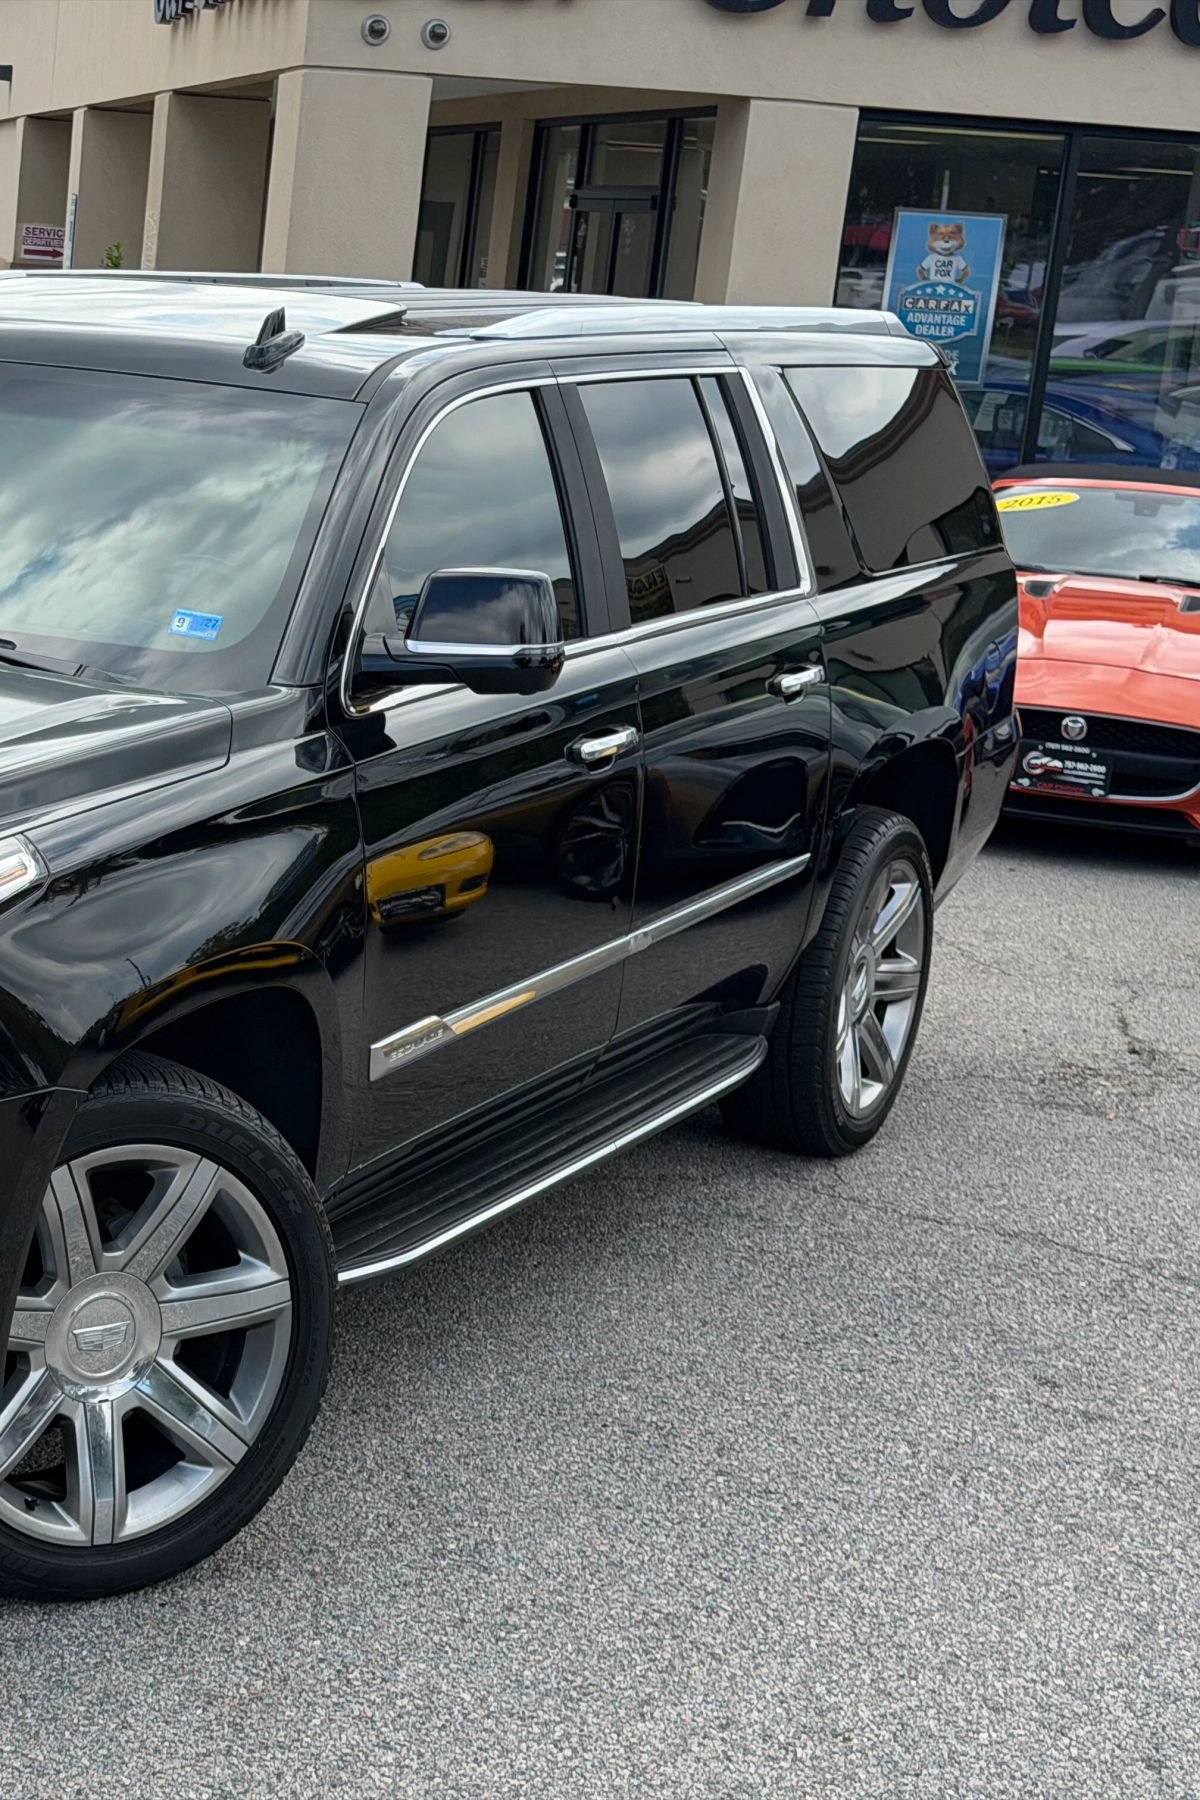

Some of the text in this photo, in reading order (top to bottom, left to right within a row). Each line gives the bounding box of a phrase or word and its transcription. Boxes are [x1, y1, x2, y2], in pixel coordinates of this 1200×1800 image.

[24, 226, 64, 238] SERVIC
[23, 238, 64, 248] DEPARTMEN
[934, 259, 954, 268] CAR
[934, 268, 952, 277] FOX
[904, 298, 973, 314] CARFAX
[906, 312, 967, 327] ADVANTAGE
[915, 324, 955, 337] DEALER
[1003, 495, 1062, 509] 2015
[176, 617, 186, 628] 9
[176, 1113, 303, 1216] DUELER
